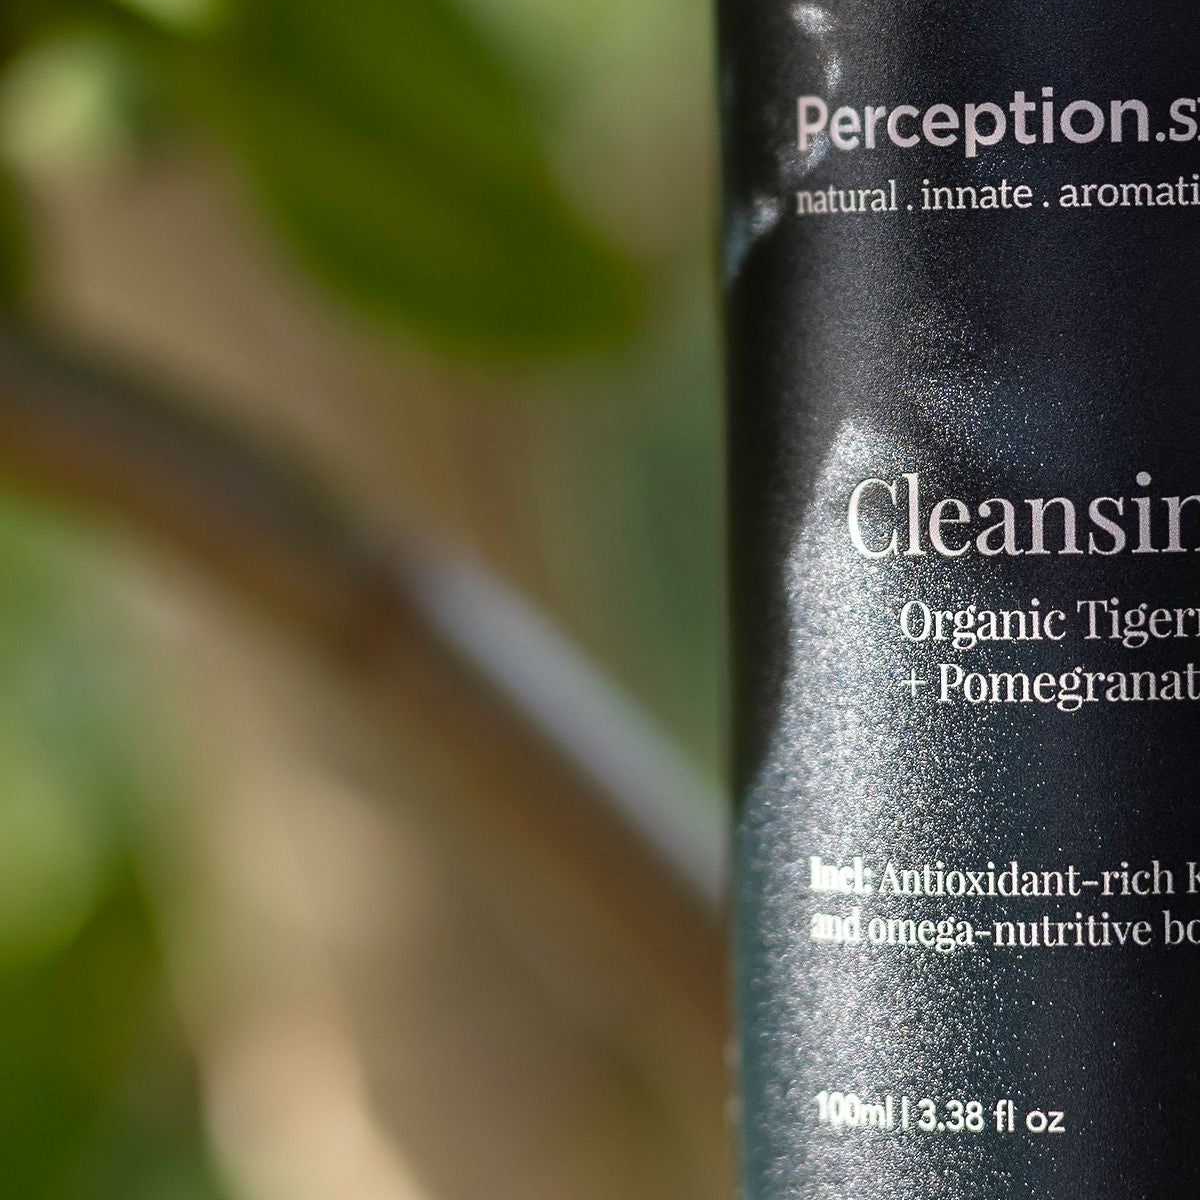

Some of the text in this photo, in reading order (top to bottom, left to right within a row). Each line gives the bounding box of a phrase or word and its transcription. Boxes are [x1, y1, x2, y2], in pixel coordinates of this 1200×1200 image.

[796, 180, 897, 214] natural
[922, 178, 1033, 211] innate
[900, 598, 1067, 650] Organic
[878, 859, 1176, 897] Antioxidant-rich
[809, 910, 863, 945] and
[868, 911, 1153, 951] omega-nutritive
[815, 1090, 893, 1128] 100ml
[917, 1098, 985, 1133] 3.38
[993, 1099, 1015, 1132] fl
[1025, 1110, 1066, 1133] oz
